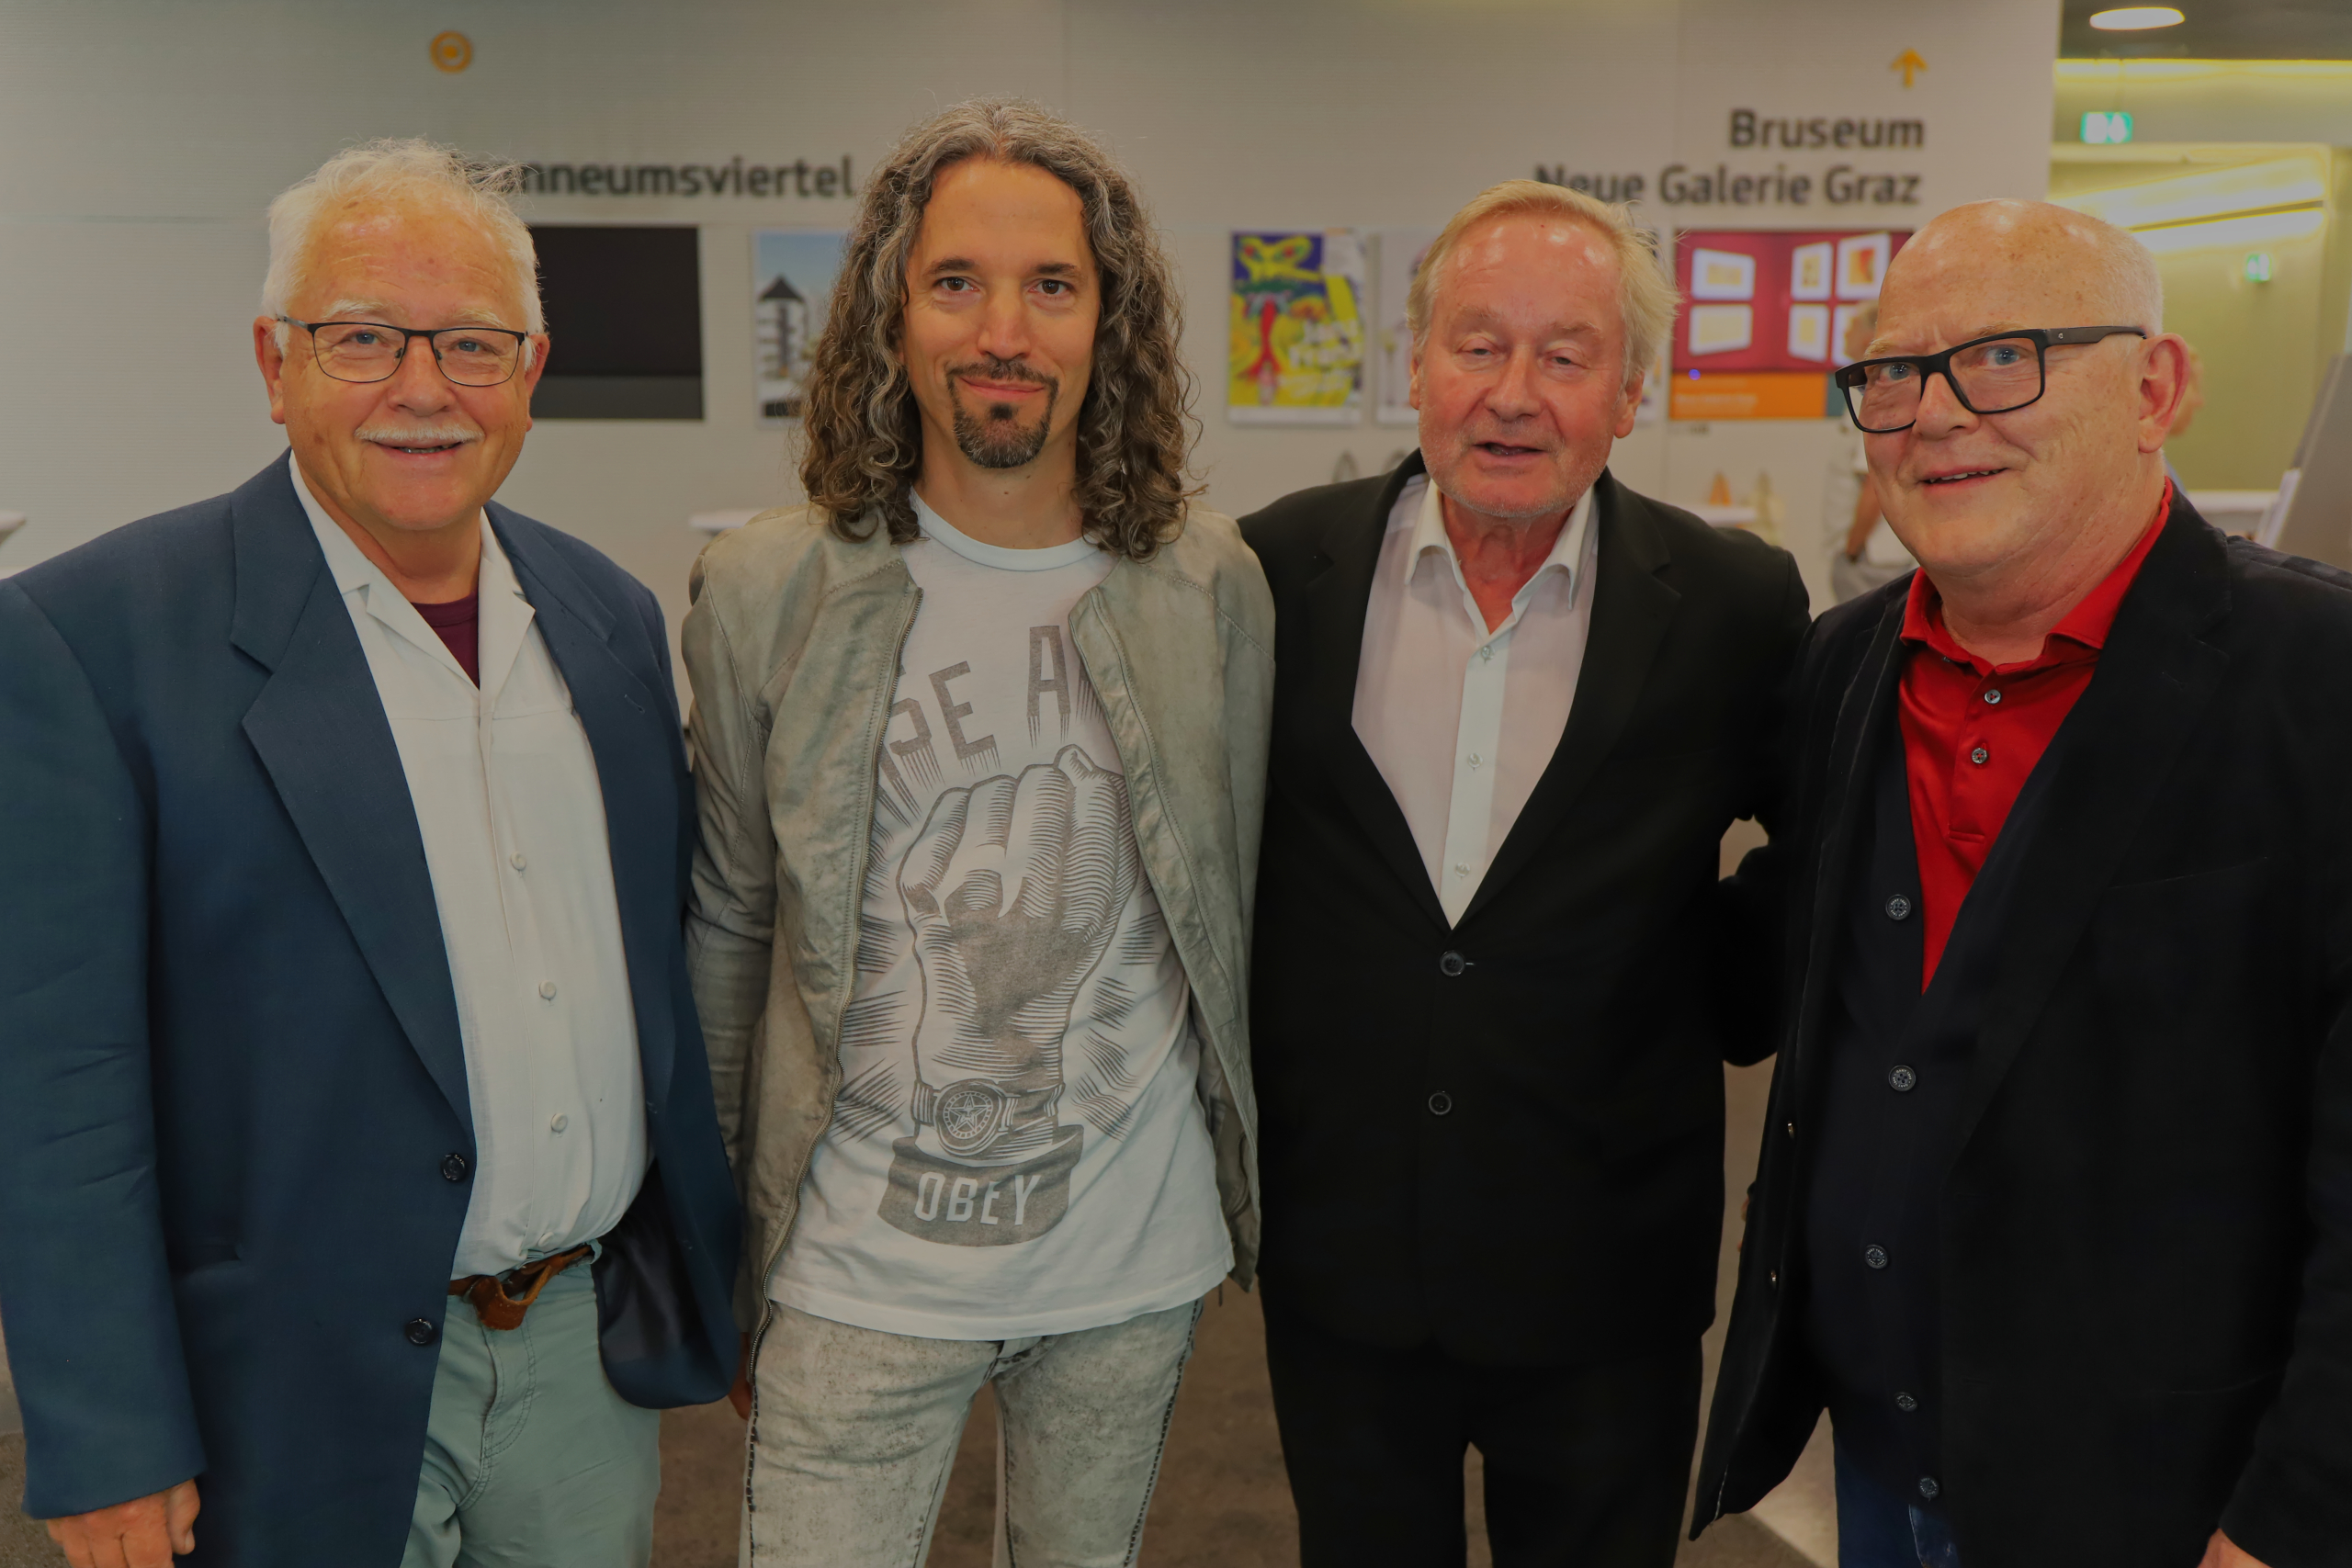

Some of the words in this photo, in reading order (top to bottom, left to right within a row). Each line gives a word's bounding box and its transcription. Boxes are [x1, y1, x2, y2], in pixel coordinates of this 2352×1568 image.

[1729, 108, 1925, 149] Bruseum
[1658, 164, 1812, 205] Galerie
[1824, 165, 1922, 205] Graz
[914, 1171, 1041, 1225] OBEY
